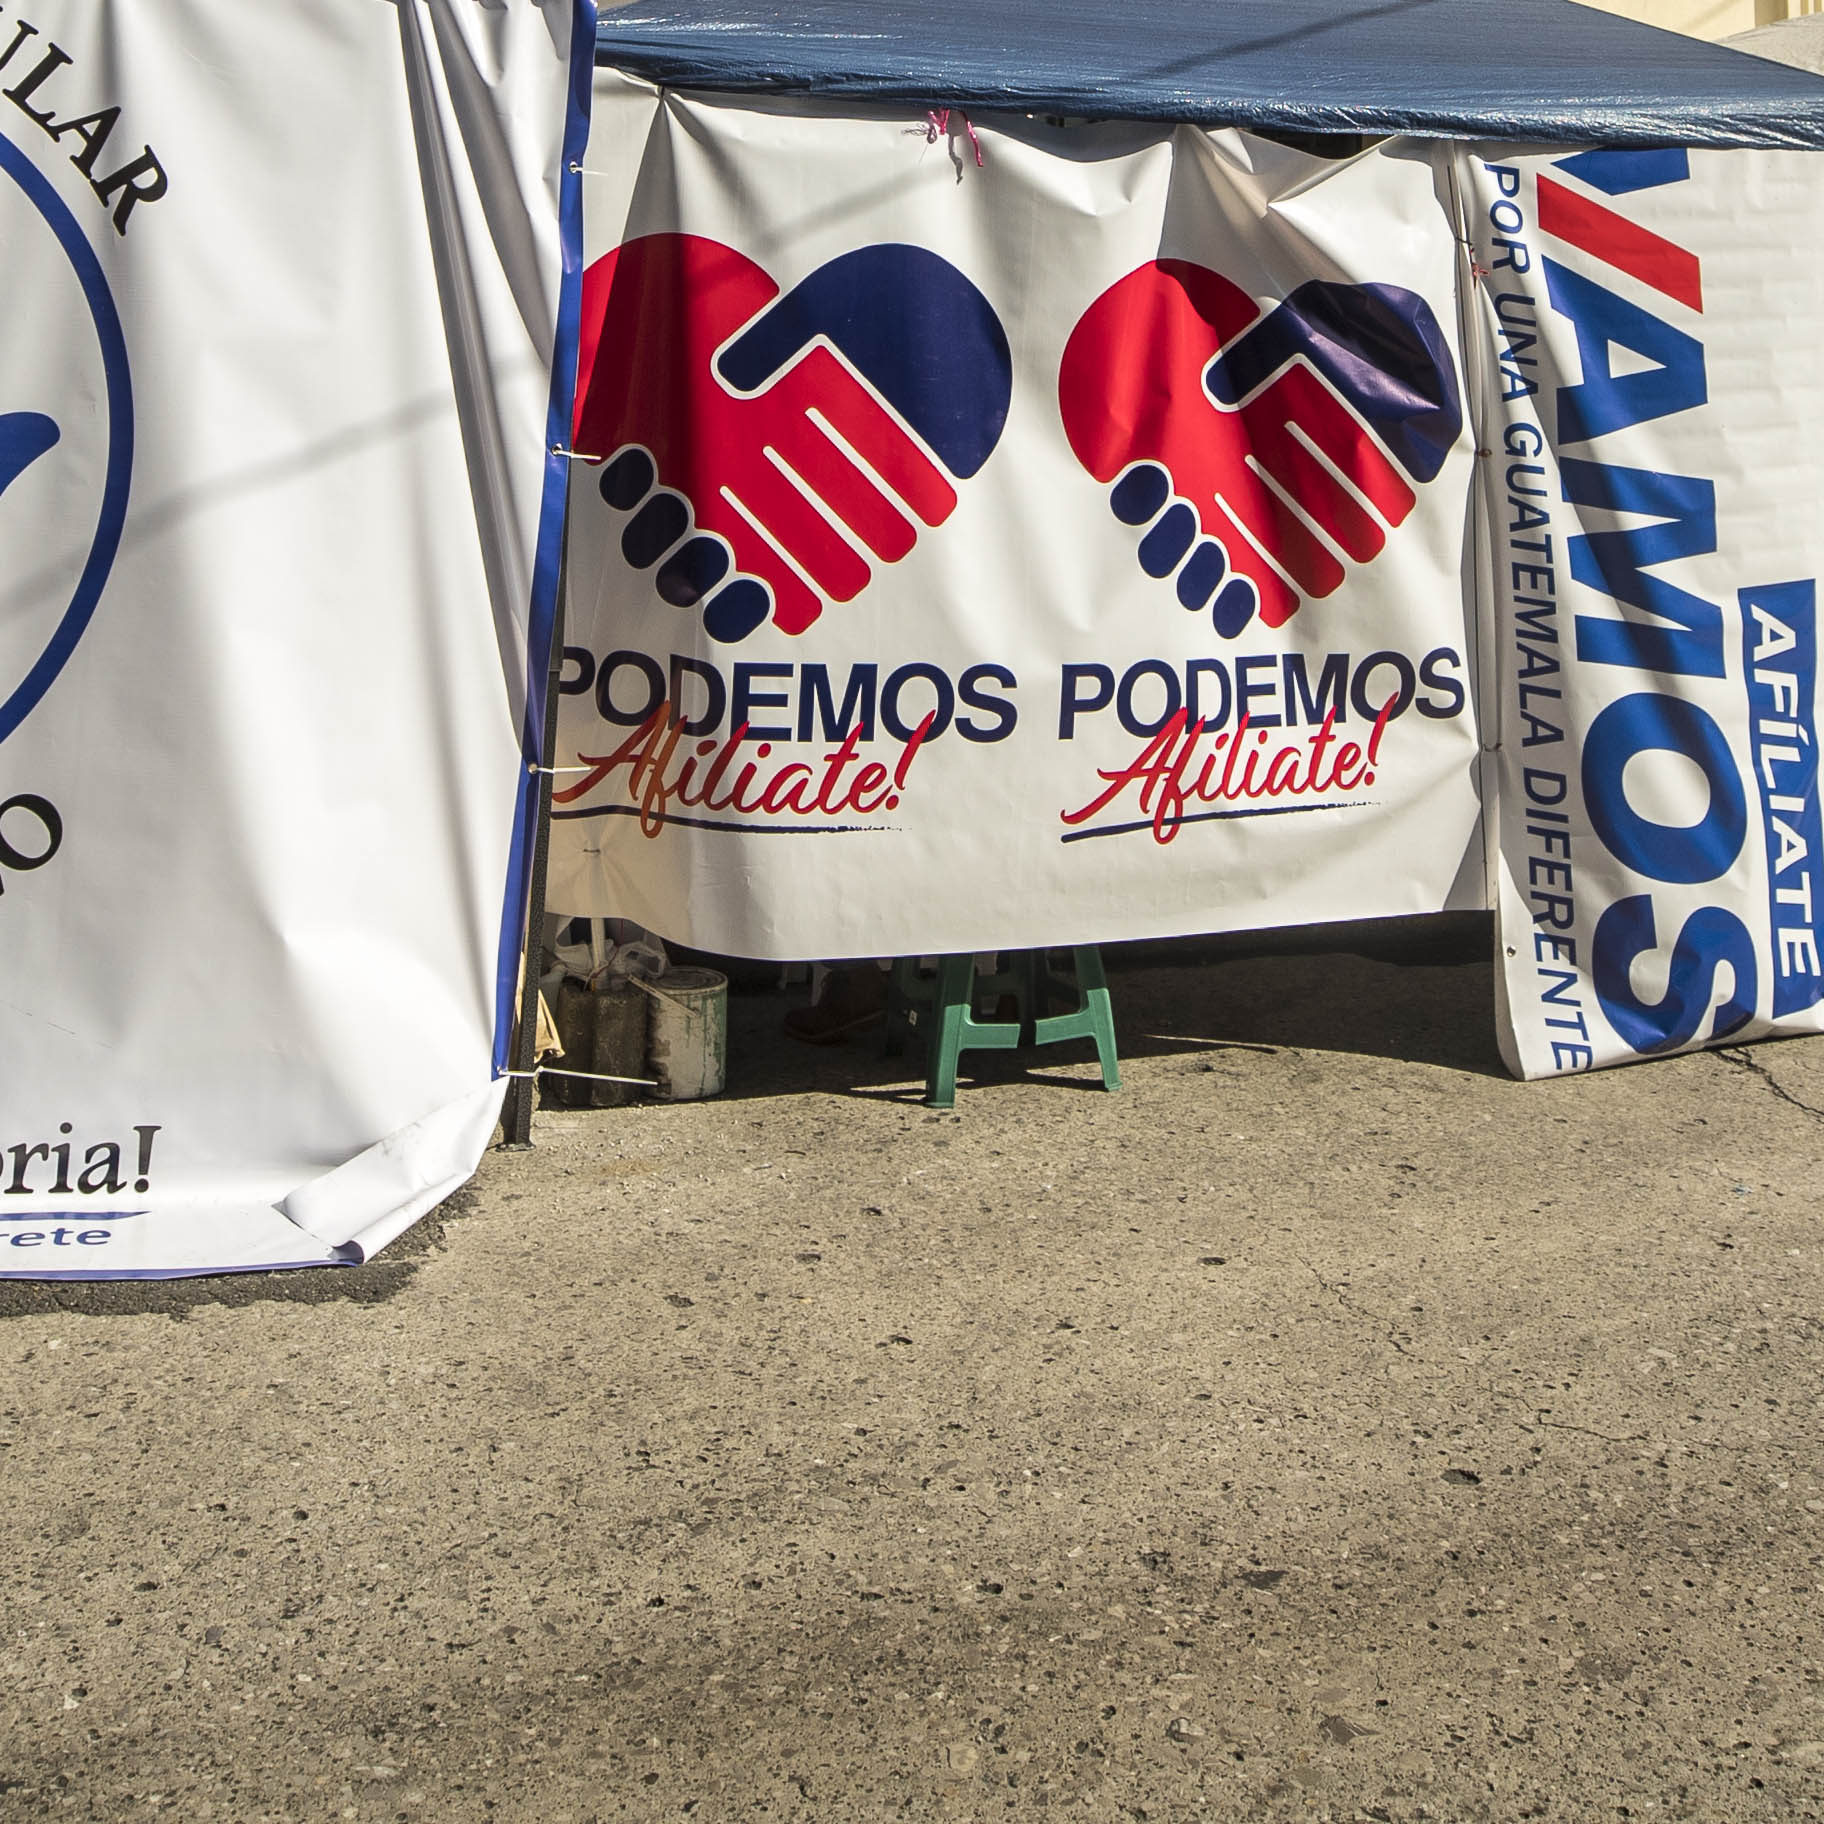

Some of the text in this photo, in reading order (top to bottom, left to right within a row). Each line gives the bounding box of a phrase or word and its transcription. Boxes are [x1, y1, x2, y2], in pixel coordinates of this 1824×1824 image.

[1484, 162, 1594, 1072] POR UNA GUATEMALA DIFERENTE
[1537, 147, 1758, 1055] VAMOS
[552, 700, 936, 838] Afiliate!
[558, 646, 1018, 743] PODEMOS
[1058, 647, 1465, 739] PODEMOS
[1060, 691, 1399, 844] Afiliate!
[1750, 604, 1821, 977] AFÍLIATE
